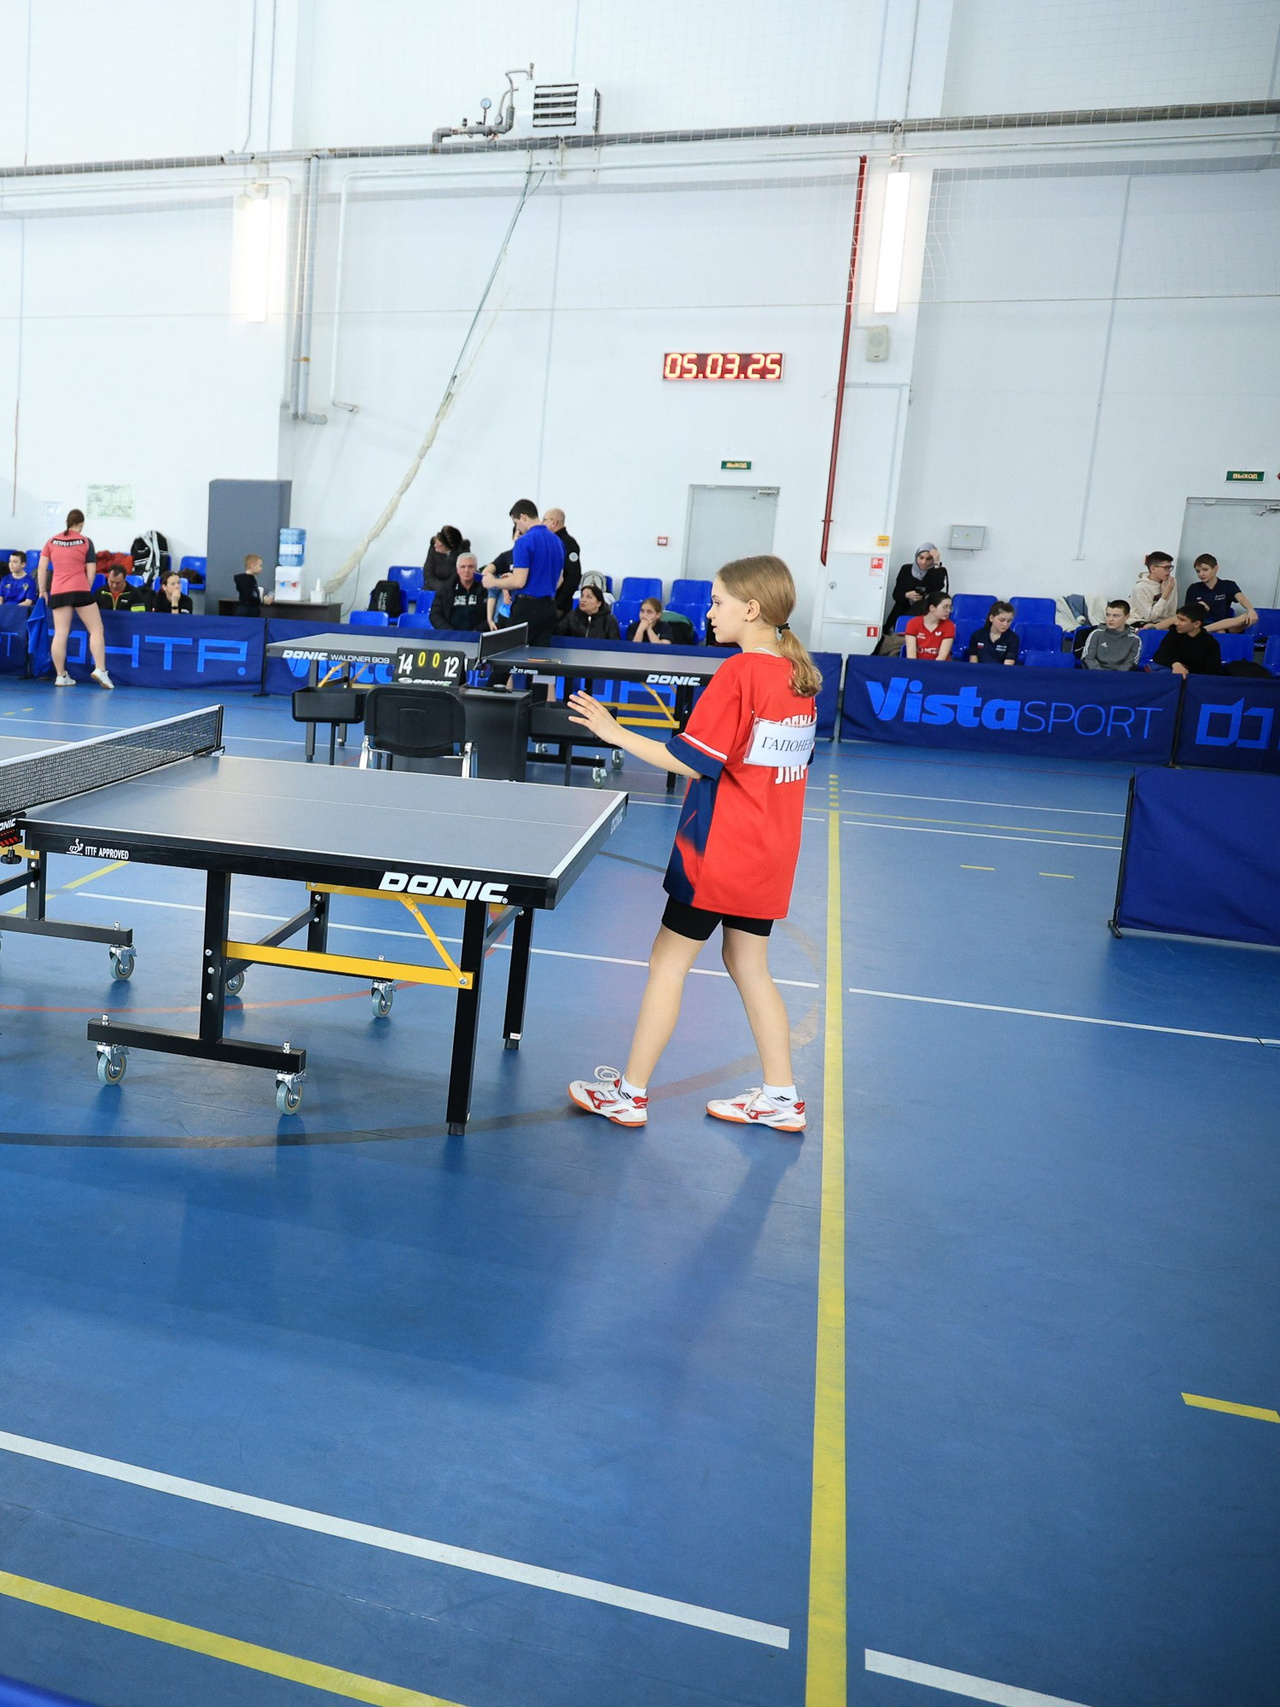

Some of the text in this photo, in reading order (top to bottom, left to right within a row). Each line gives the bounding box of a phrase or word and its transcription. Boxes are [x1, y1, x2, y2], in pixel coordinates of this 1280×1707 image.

[664, 352, 782, 379] 05.03.25
[282, 650, 328, 660] DONIC
[330, 654, 371, 663] WALDNER
[398, 653, 413, 675] 14
[418, 651, 426, 667] 0
[432, 652, 440, 668] 0
[444, 656, 458, 677] 12
[646, 674, 701, 686] DONIC
[85, 846, 129, 860] ITTF APPROVED
[378, 871, 509, 904] DONIC
